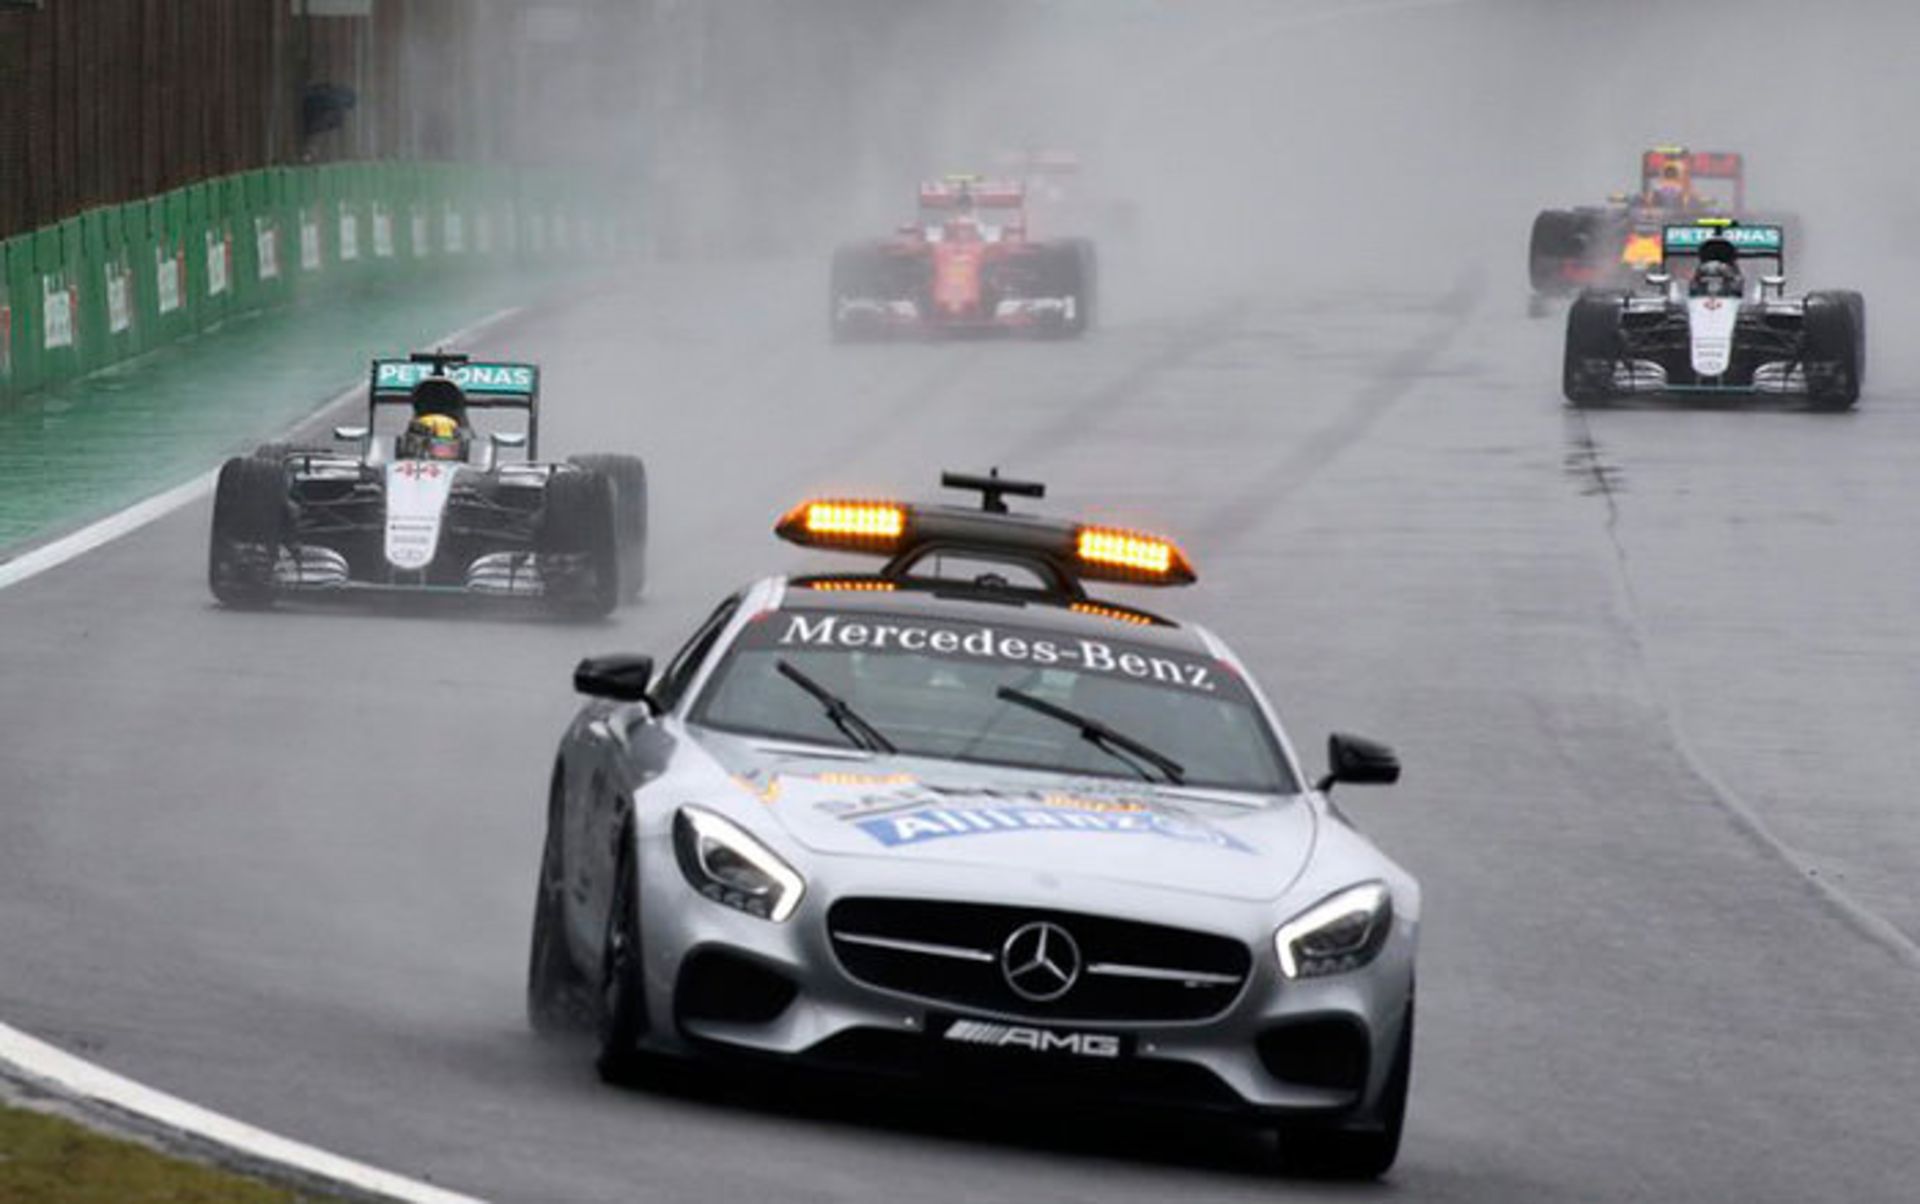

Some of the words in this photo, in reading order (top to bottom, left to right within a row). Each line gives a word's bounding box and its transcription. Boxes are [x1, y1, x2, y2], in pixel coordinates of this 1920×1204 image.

[779, 614, 1217, 692] Mercedes-Benz
[893, 807, 1142, 840] Allianz
[998, 1026, 1120, 1057] AMG
